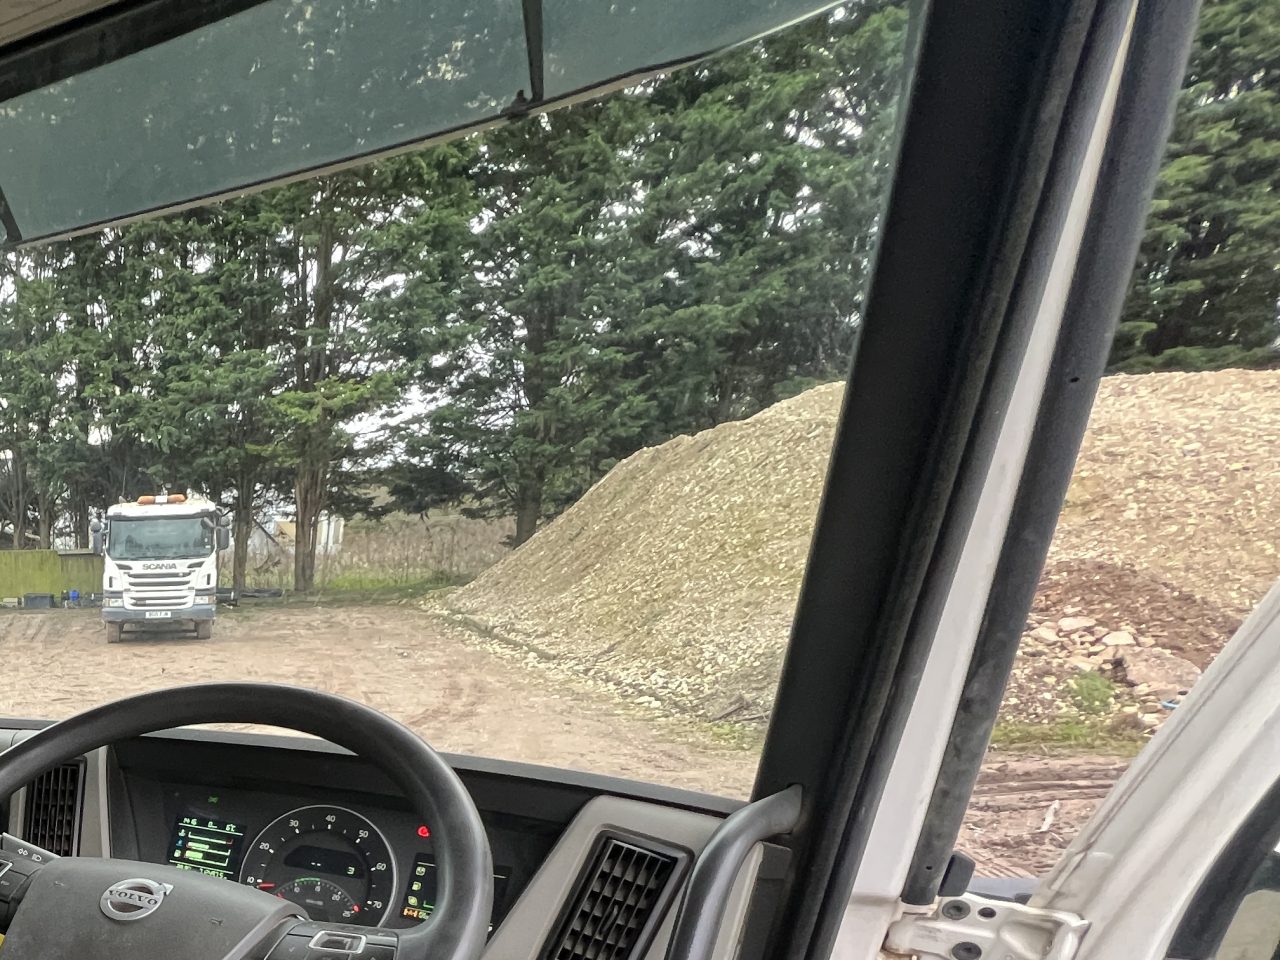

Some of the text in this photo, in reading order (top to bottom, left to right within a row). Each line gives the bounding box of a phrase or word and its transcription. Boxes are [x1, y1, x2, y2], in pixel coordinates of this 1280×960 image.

[358, 830, 369, 838] 50
[259, 842, 270, 850] 20
[376, 863, 387, 871] 60
[246, 876, 255, 884] 10
[108, 889, 158, 906] VOLVO
[372, 901, 382, 909] 70
